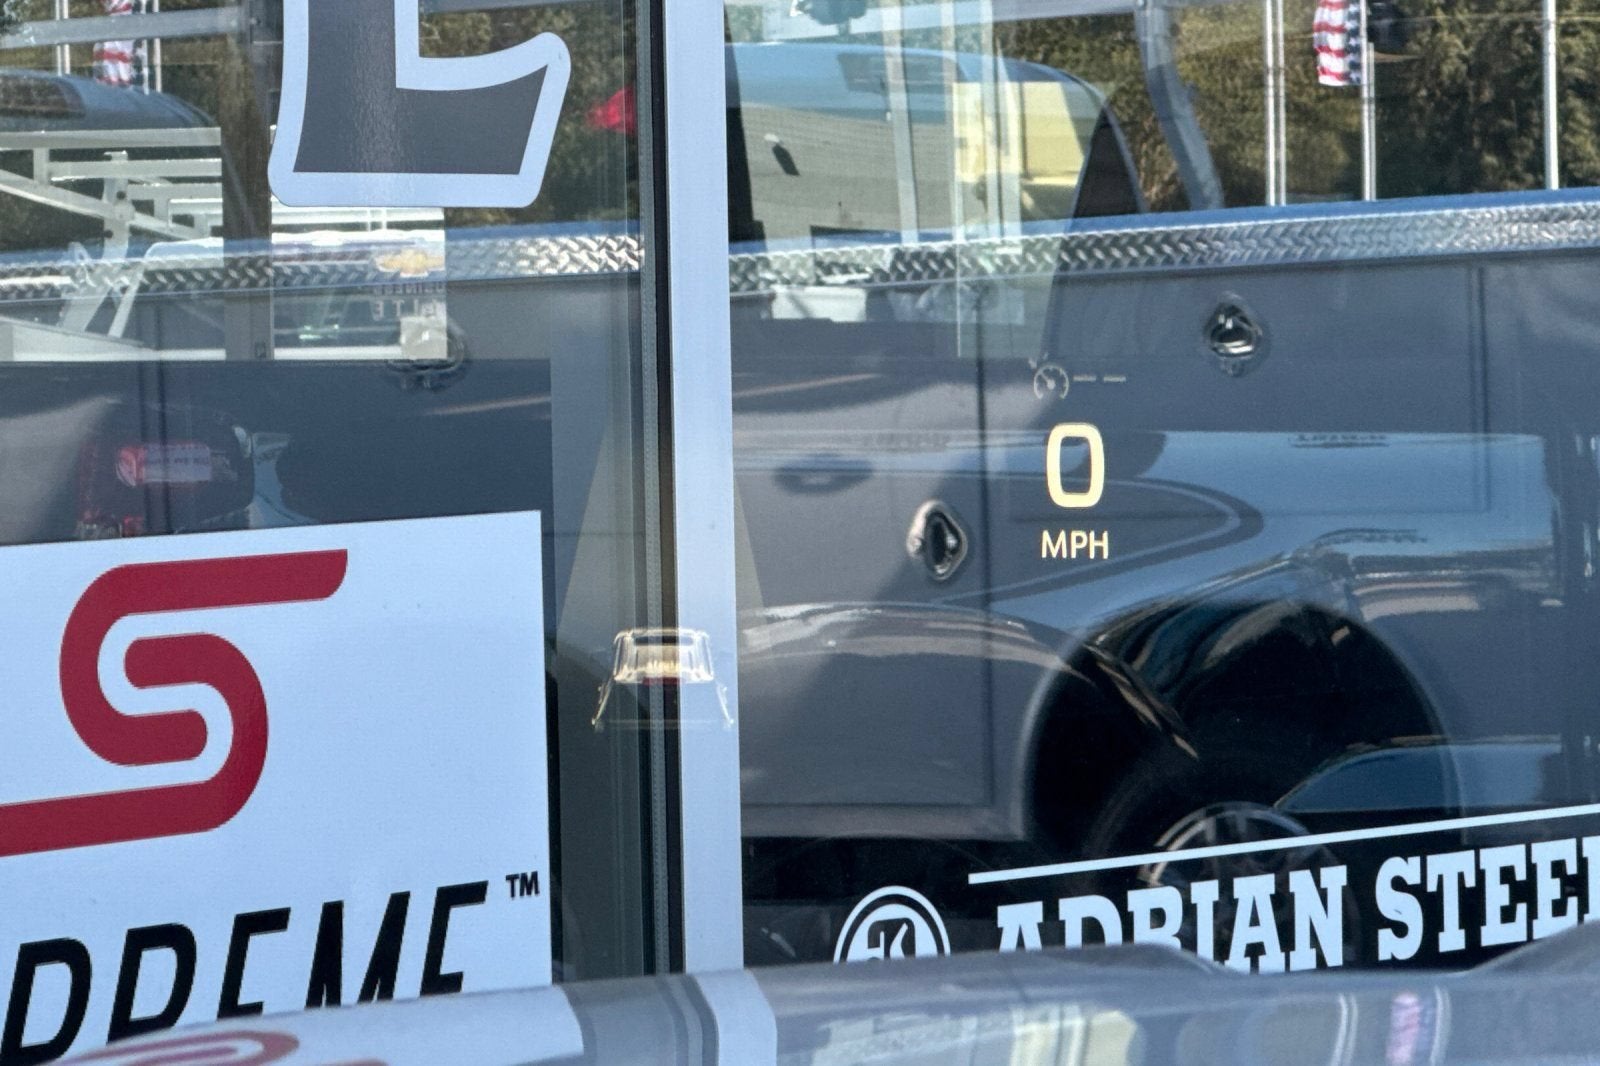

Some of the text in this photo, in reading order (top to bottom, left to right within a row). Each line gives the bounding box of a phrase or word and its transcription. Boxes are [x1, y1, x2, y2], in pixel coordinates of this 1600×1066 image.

[1046, 422, 1105, 508] 0
[1041, 529, 1109, 560] MPH
[505, 871, 539, 898] TM
